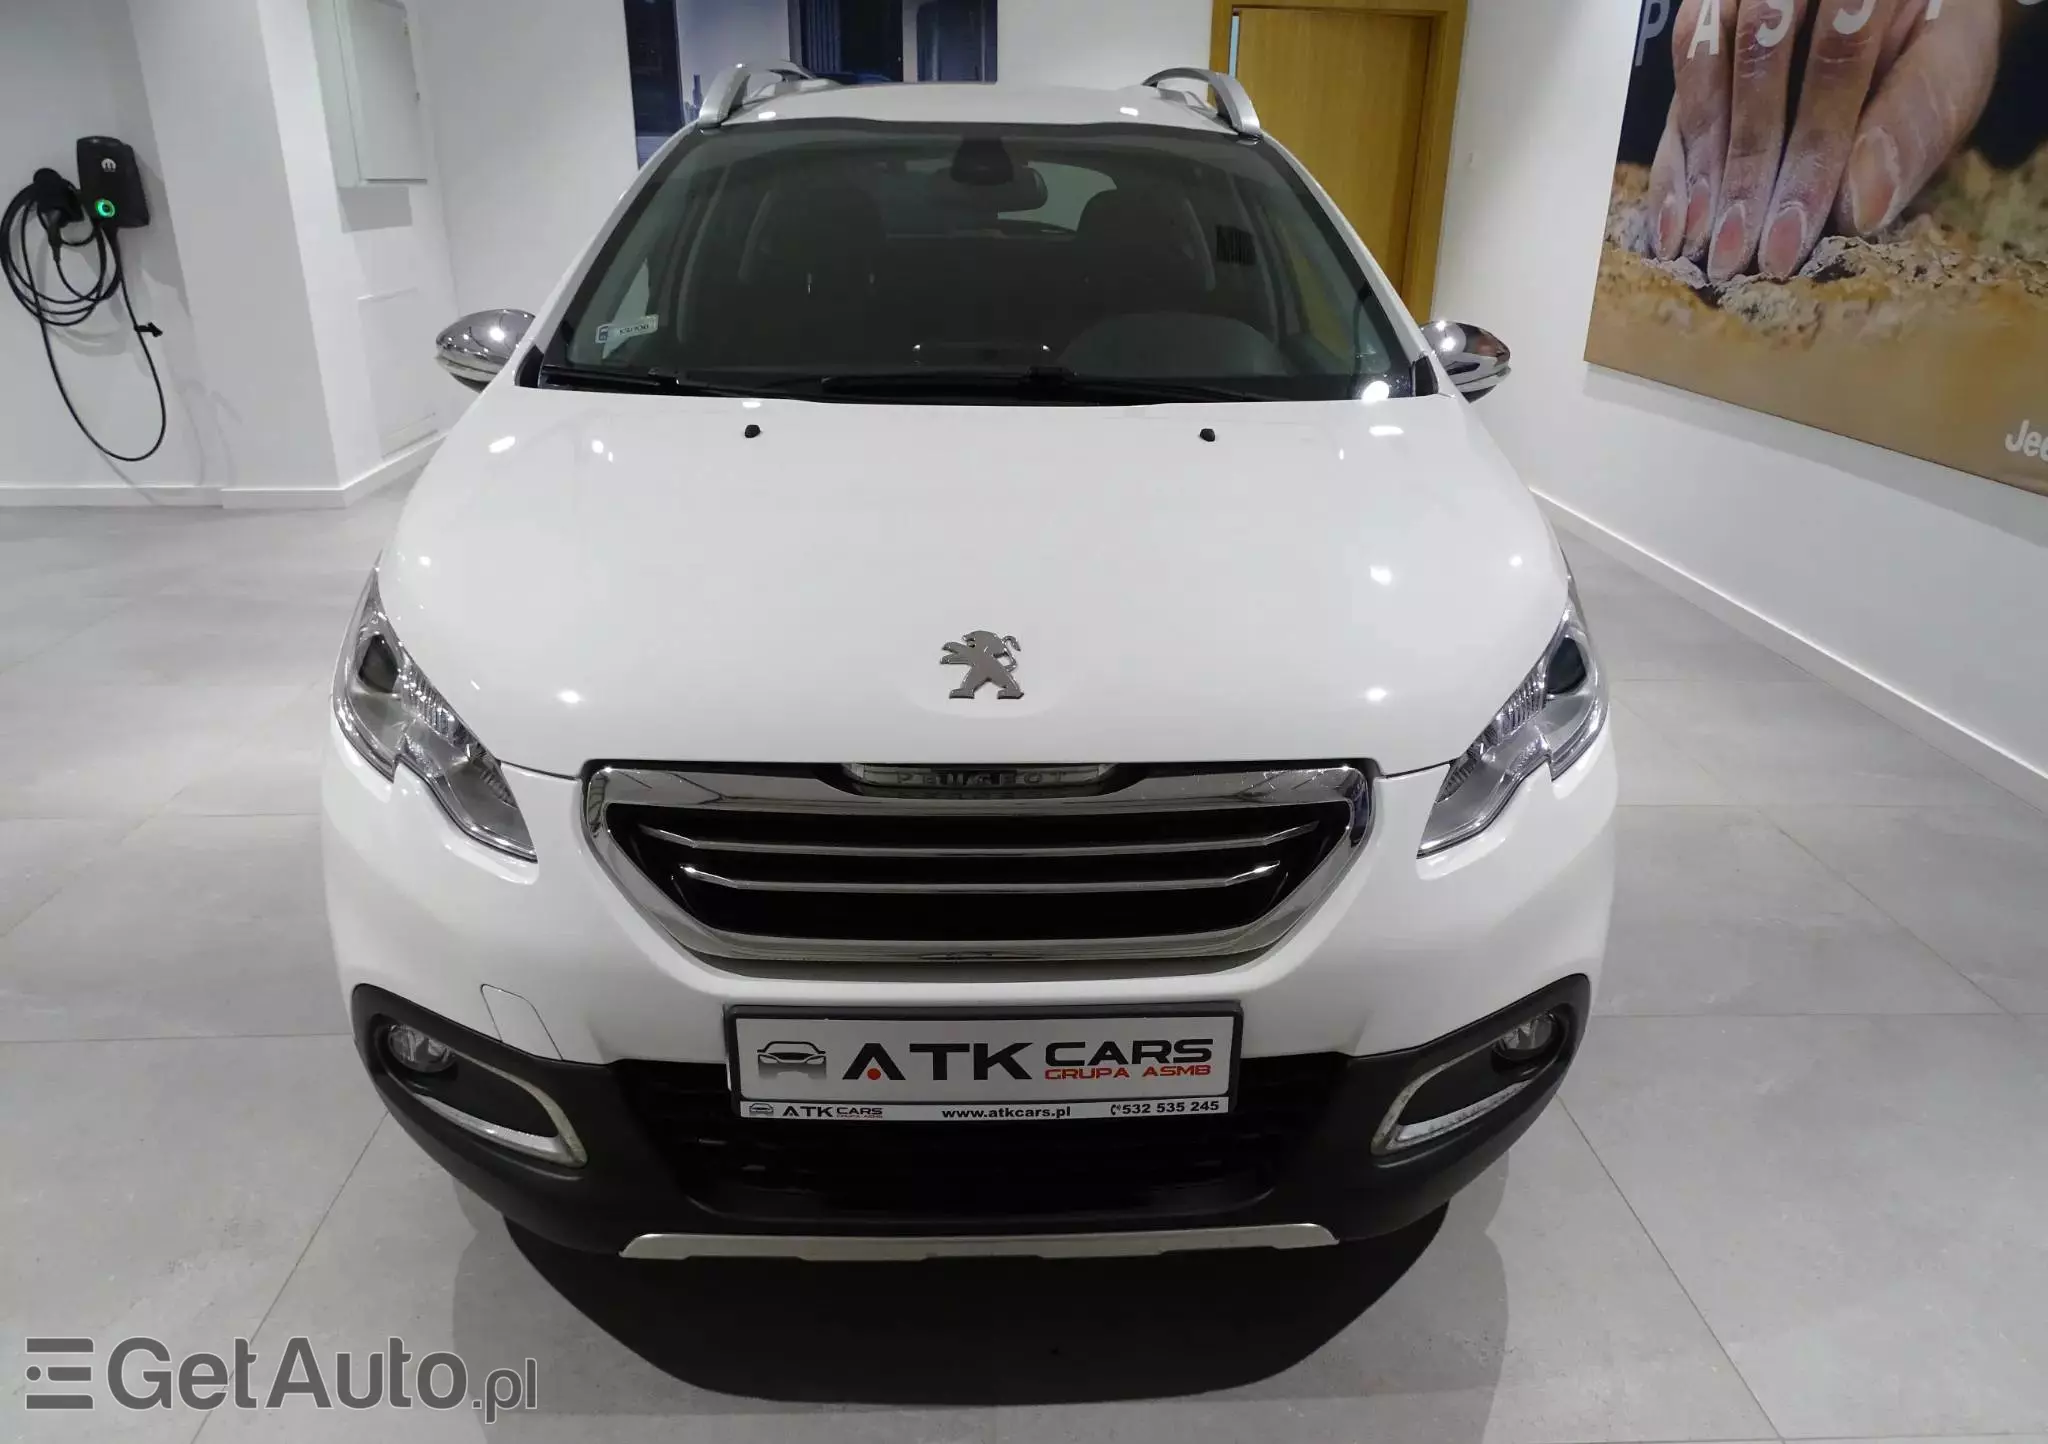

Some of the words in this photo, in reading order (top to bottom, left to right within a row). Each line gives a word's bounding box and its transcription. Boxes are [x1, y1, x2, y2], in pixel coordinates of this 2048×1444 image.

[842, 1042, 1034, 1081] ATK
[1045, 1038, 1214, 1066] CARS
[1045, 1067, 1129, 1081] GRUPA
[1142, 1064, 1212, 1078] ASMB
[782, 1105, 834, 1118] ATK
[836, 1106, 883, 1115] CARS
[942, 1106, 1071, 1119] www.atkcars.pl
[1122, 1103, 1151, 1115] 532
[1156, 1102, 1185, 1113] 535
[1190, 1100, 1219, 1112] 245
